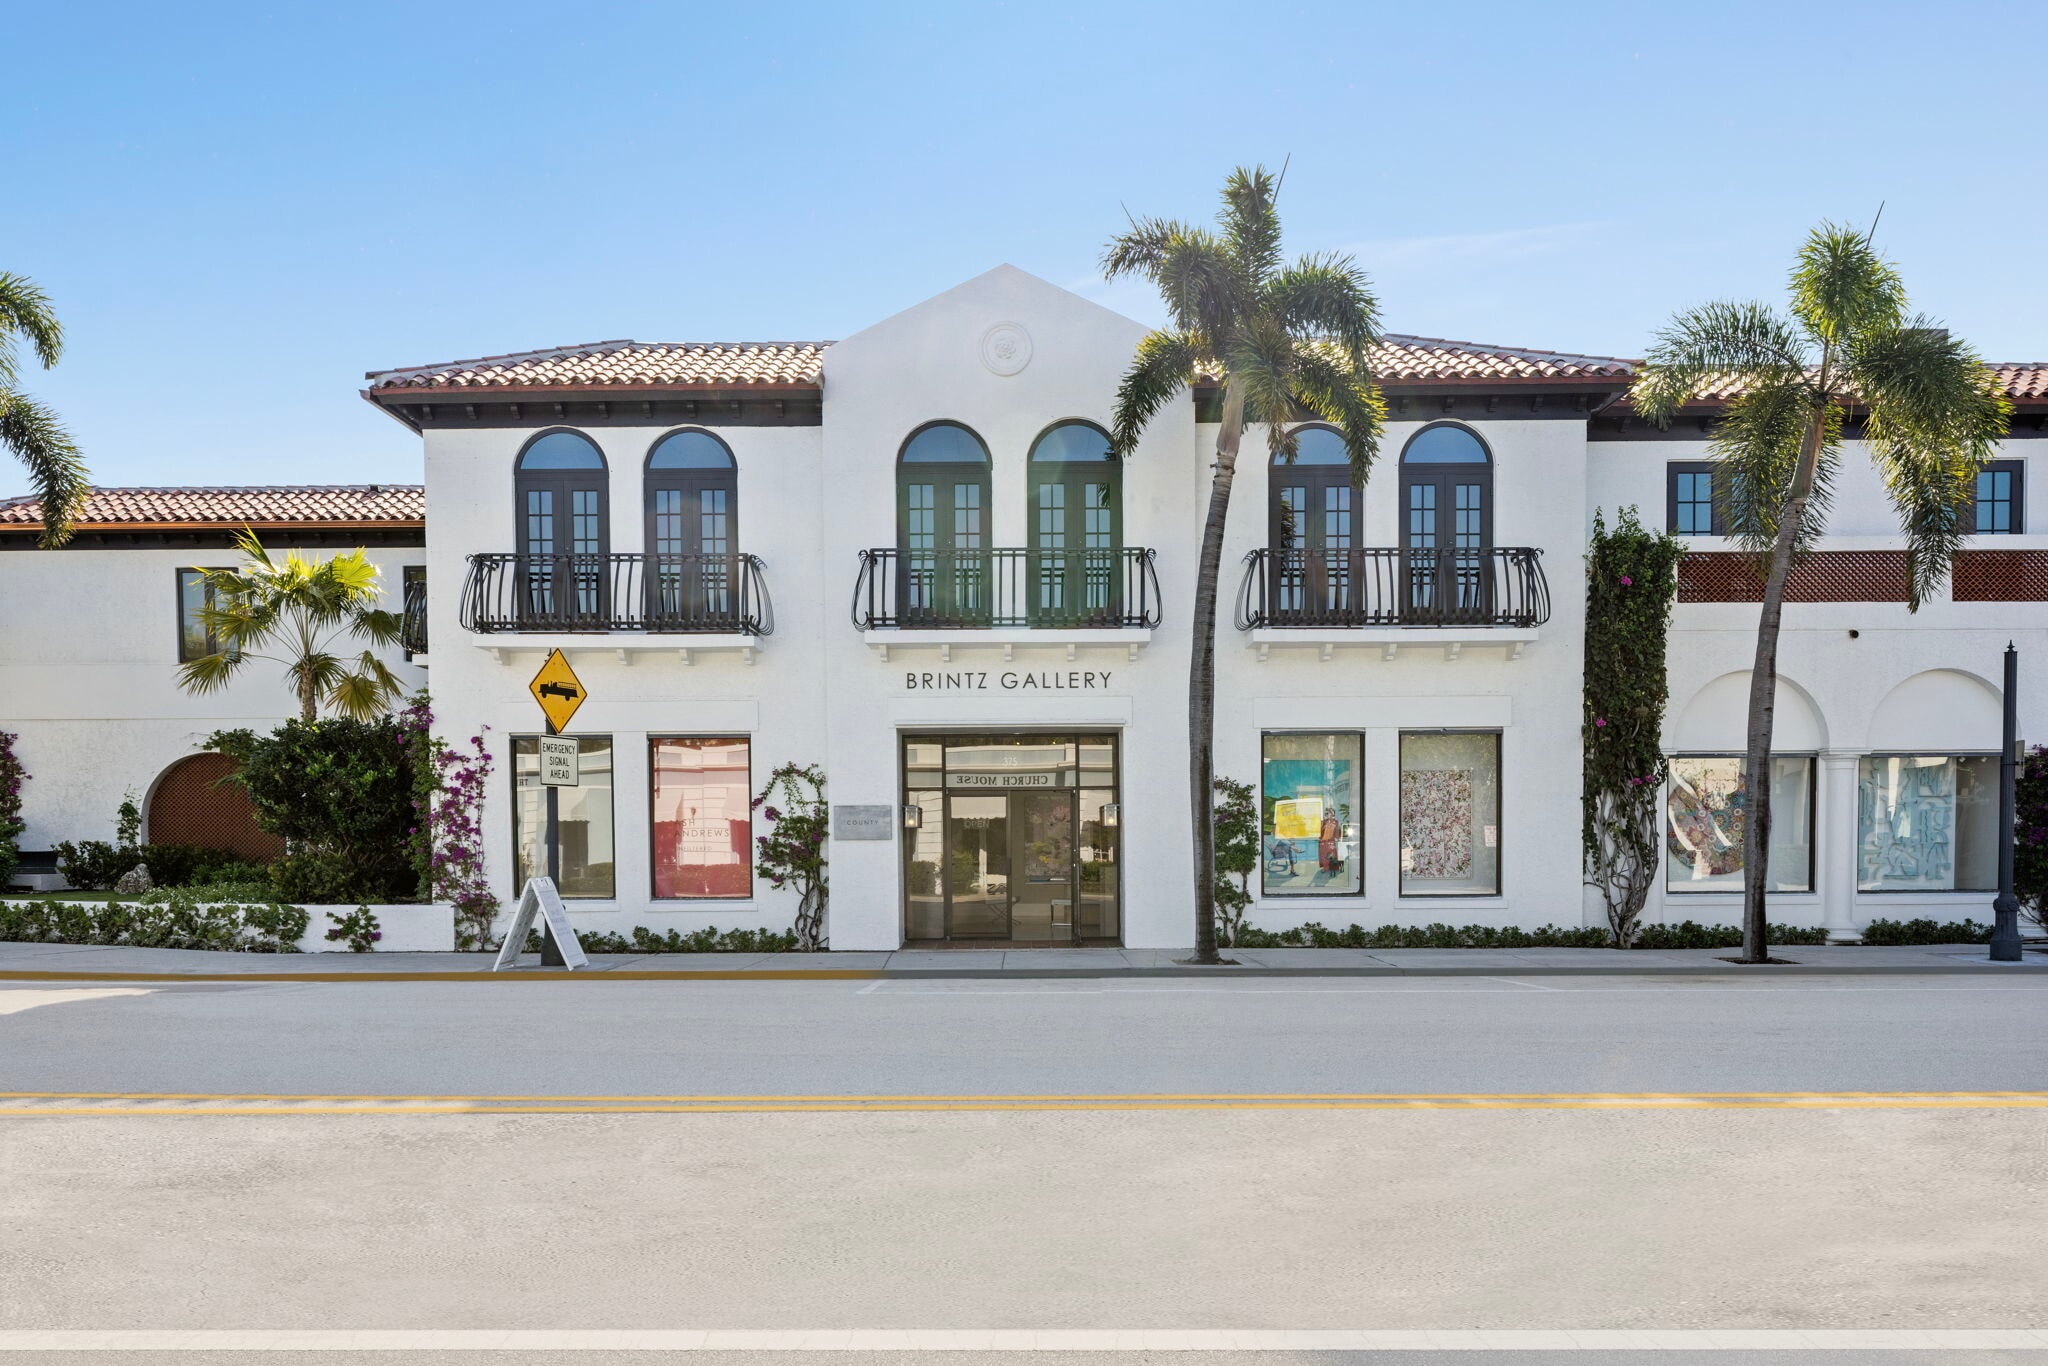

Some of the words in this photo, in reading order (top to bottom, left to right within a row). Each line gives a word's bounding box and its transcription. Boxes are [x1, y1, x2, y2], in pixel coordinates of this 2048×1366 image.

[906, 672, 987, 689] BRINTZ
[1000, 672, 1112, 689] GALLERY
[542, 742, 576, 755] EMERGENCY
[549, 756, 570, 767] SIGNAL
[549, 769, 570, 780] AHEAD
[674, 829, 730, 838] ANDREWS
